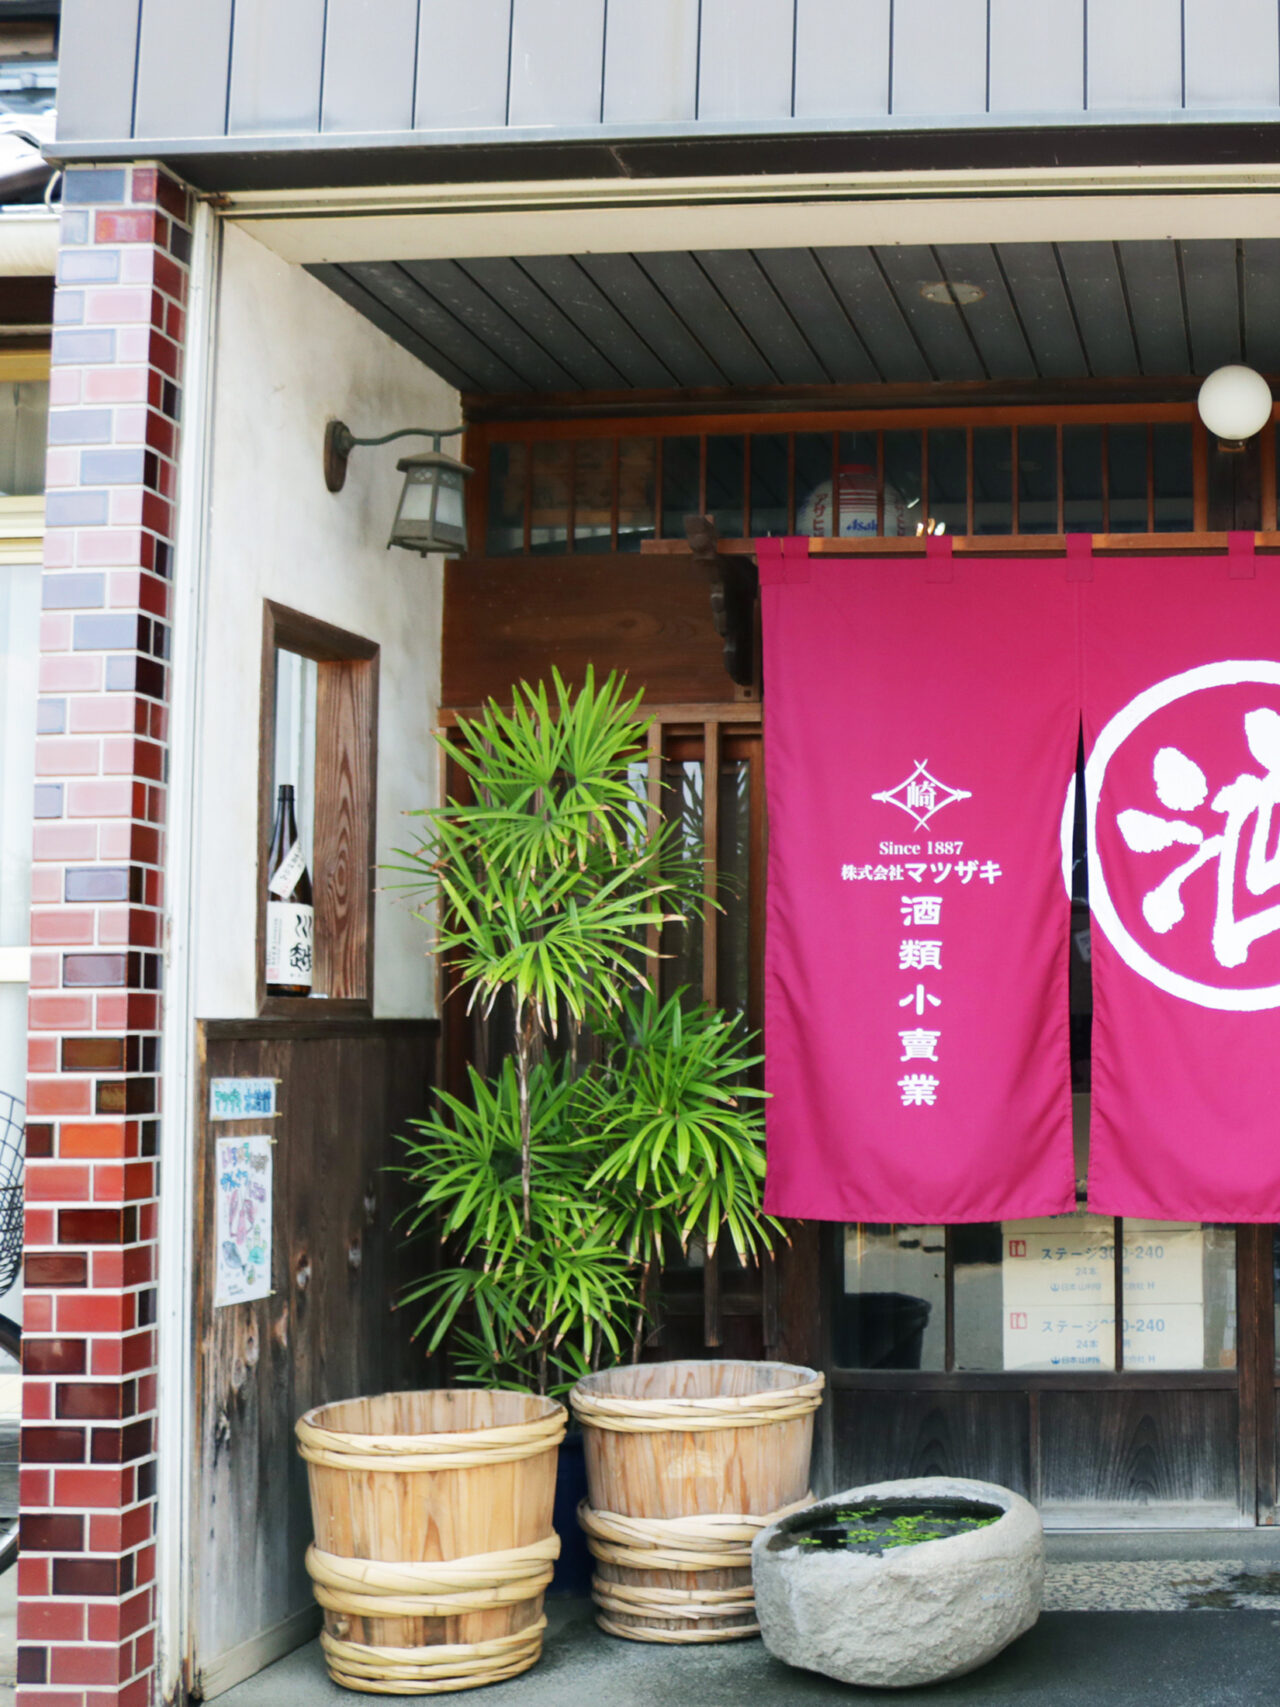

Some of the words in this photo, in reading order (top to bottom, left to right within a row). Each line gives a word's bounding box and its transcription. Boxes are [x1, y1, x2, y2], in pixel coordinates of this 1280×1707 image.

[847, 518, 878, 531] Asah
[879, 841, 921, 855] Since
[926, 841, 964, 855] 1887
[841, 859, 1003, 885] 株式会社マツザキ
